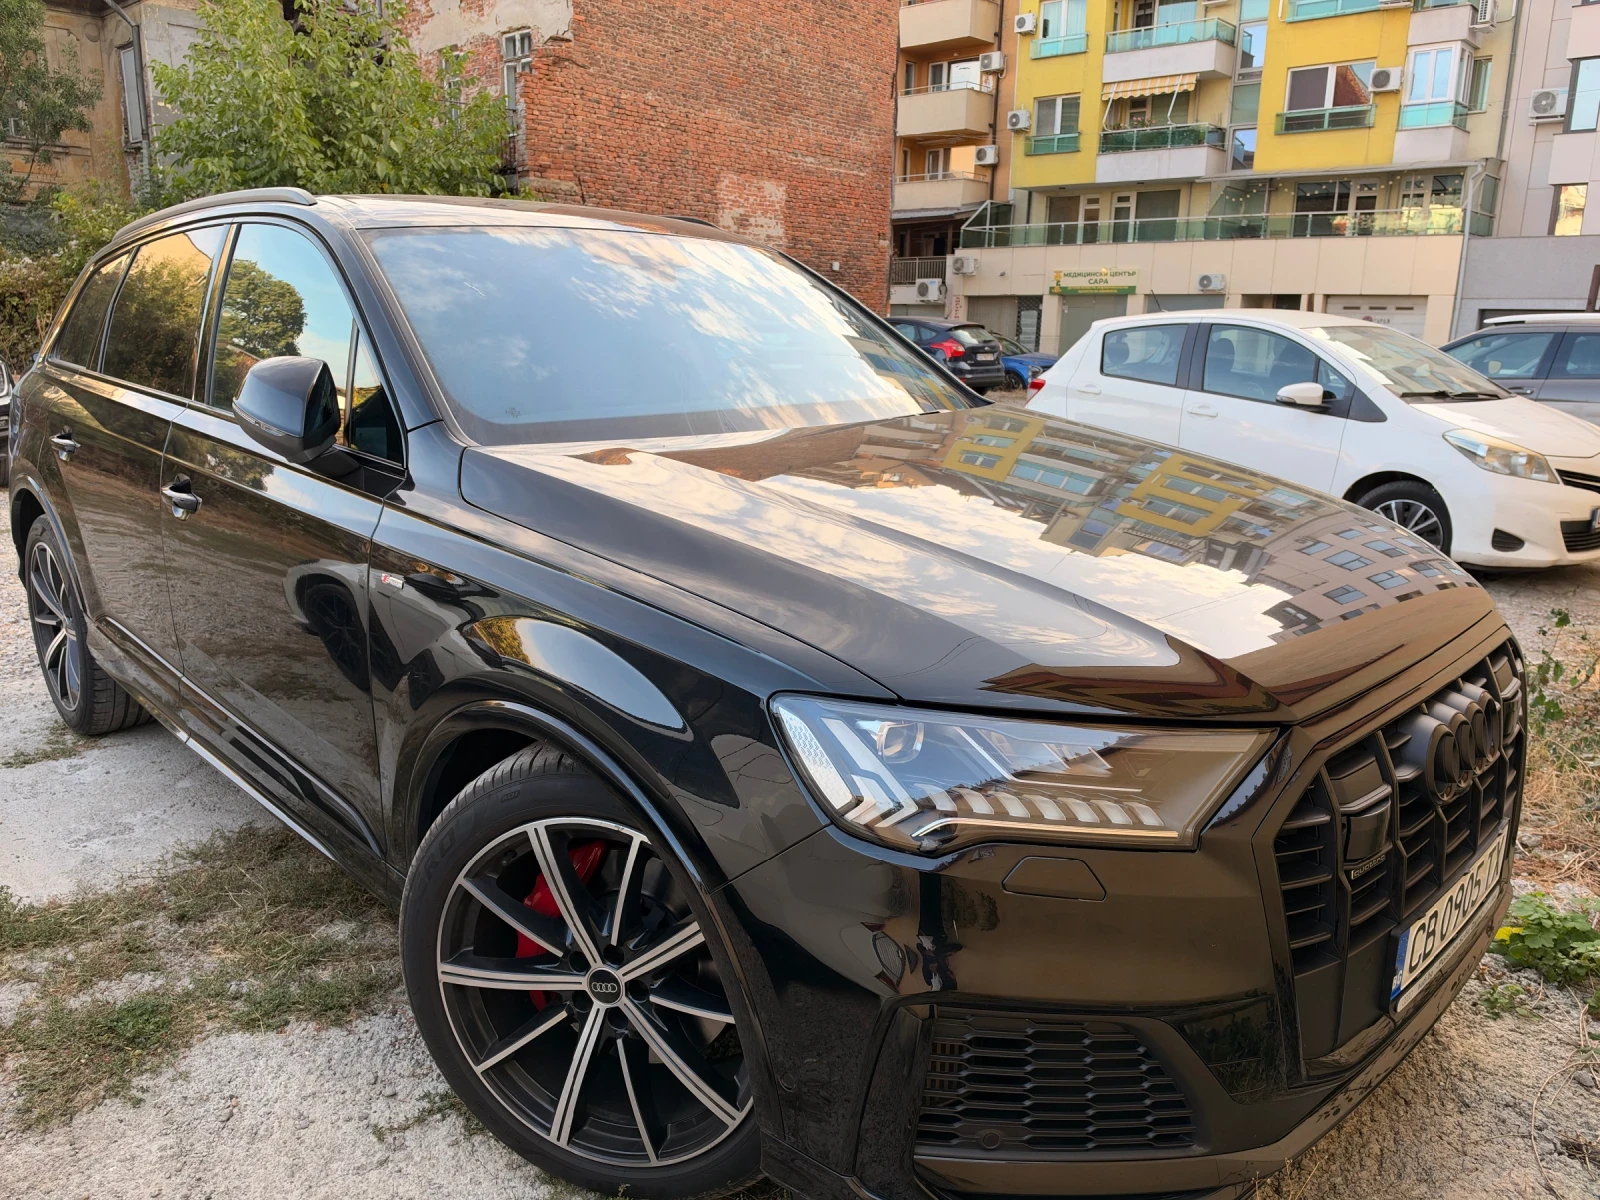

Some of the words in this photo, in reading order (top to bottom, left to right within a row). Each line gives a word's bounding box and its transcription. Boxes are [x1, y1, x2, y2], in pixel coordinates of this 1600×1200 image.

[1408, 909, 1439, 975] CB
[1439, 859, 1485, 942] 0905
[1391, 969, 1403, 990] BG
